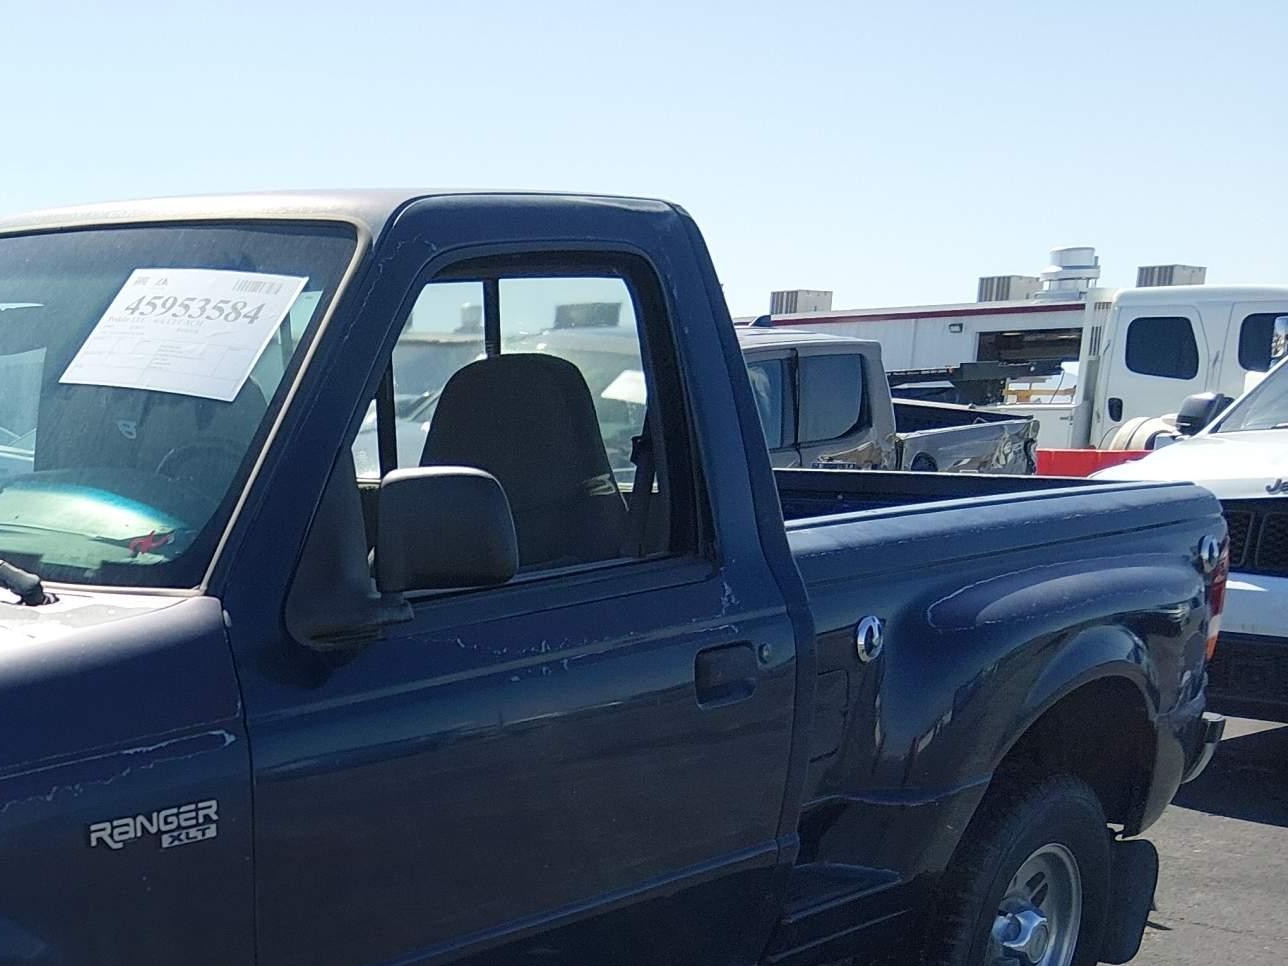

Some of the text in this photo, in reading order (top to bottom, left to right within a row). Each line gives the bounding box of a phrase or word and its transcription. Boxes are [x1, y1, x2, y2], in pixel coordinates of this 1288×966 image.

[124, 294, 266, 325] 45953584
[89, 799, 220, 850] RANGER
[166, 825, 214, 847] XLT
